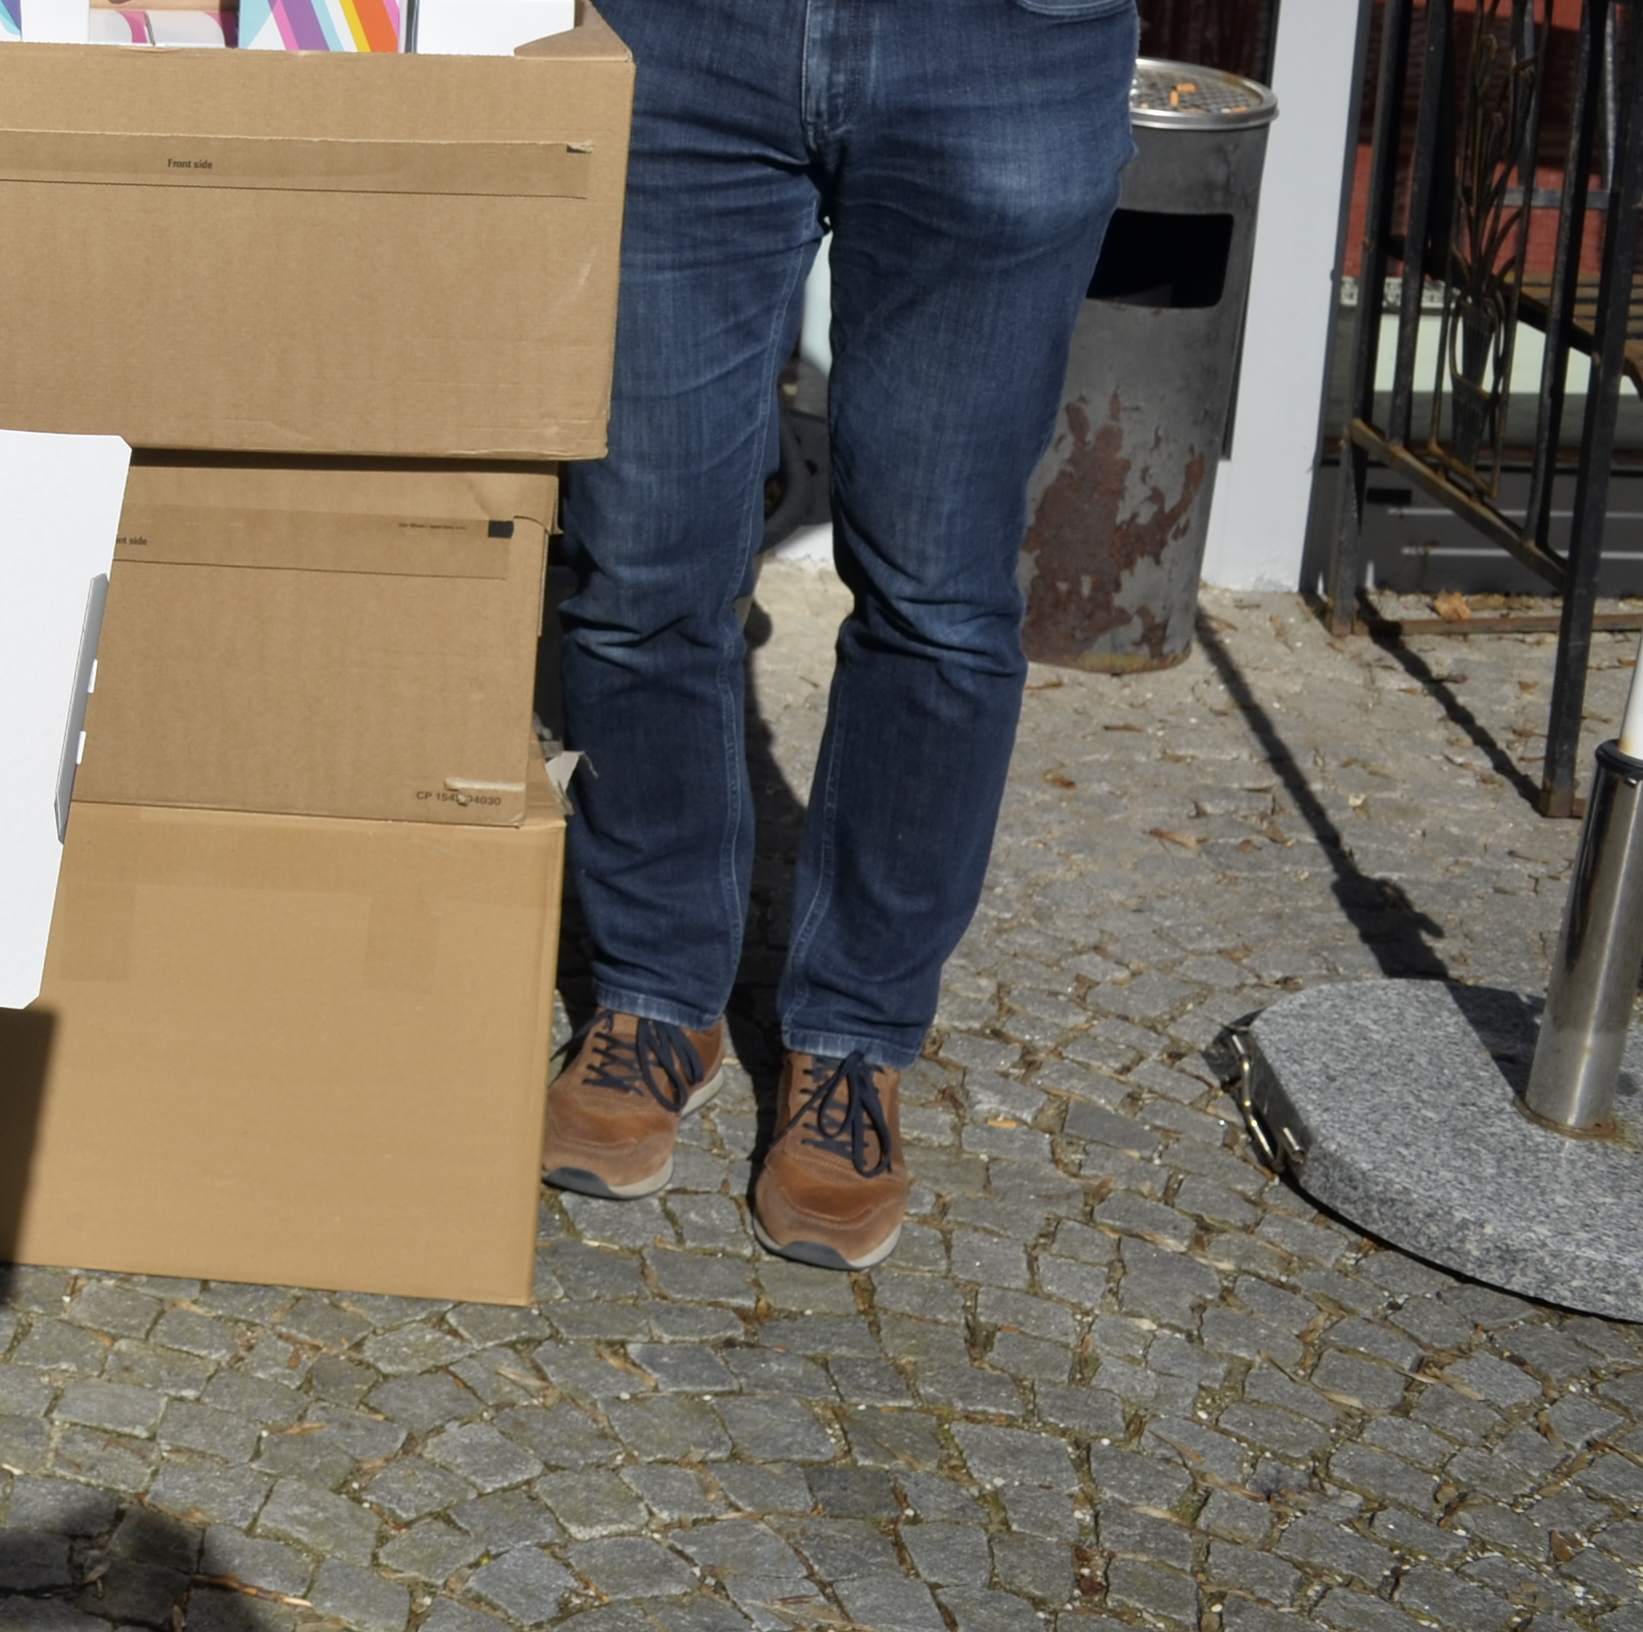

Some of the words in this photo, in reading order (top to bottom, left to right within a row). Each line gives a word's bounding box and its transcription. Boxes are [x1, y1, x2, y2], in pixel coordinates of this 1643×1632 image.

[167, 158, 192, 168] Front
[193, 159, 213, 169] side
[128, 536, 148, 546] side
[416, 790, 433, 800] CP
